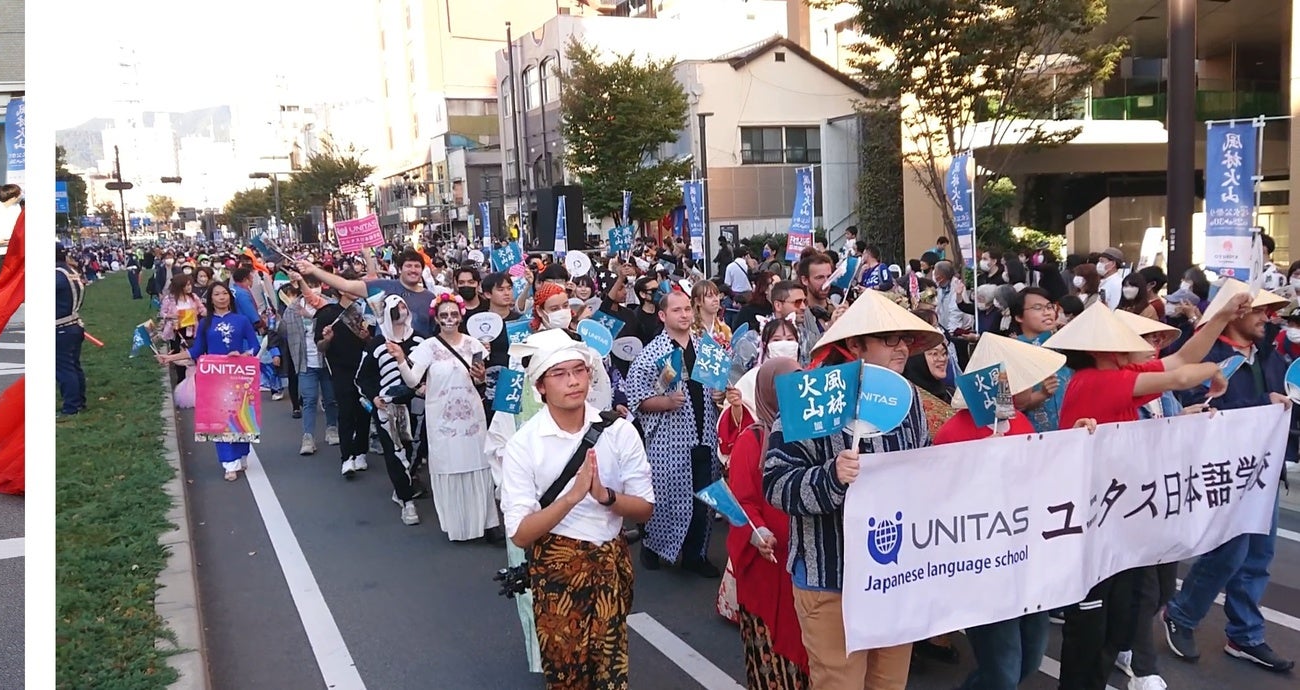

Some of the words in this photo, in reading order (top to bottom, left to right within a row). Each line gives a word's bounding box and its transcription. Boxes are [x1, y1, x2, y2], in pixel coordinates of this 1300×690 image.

[200, 363, 256, 376] UNITAS
[506, 372, 523, 402] 火山
[798, 374, 824, 421] 火山
[824, 369, 847, 414] 風林
[860, 391, 898, 406] NITAS
[911, 506, 1029, 549] UNITAS
[865, 566, 925, 594] Japanese
[927, 557, 992, 578] language
[995, 545, 1029, 567] school
